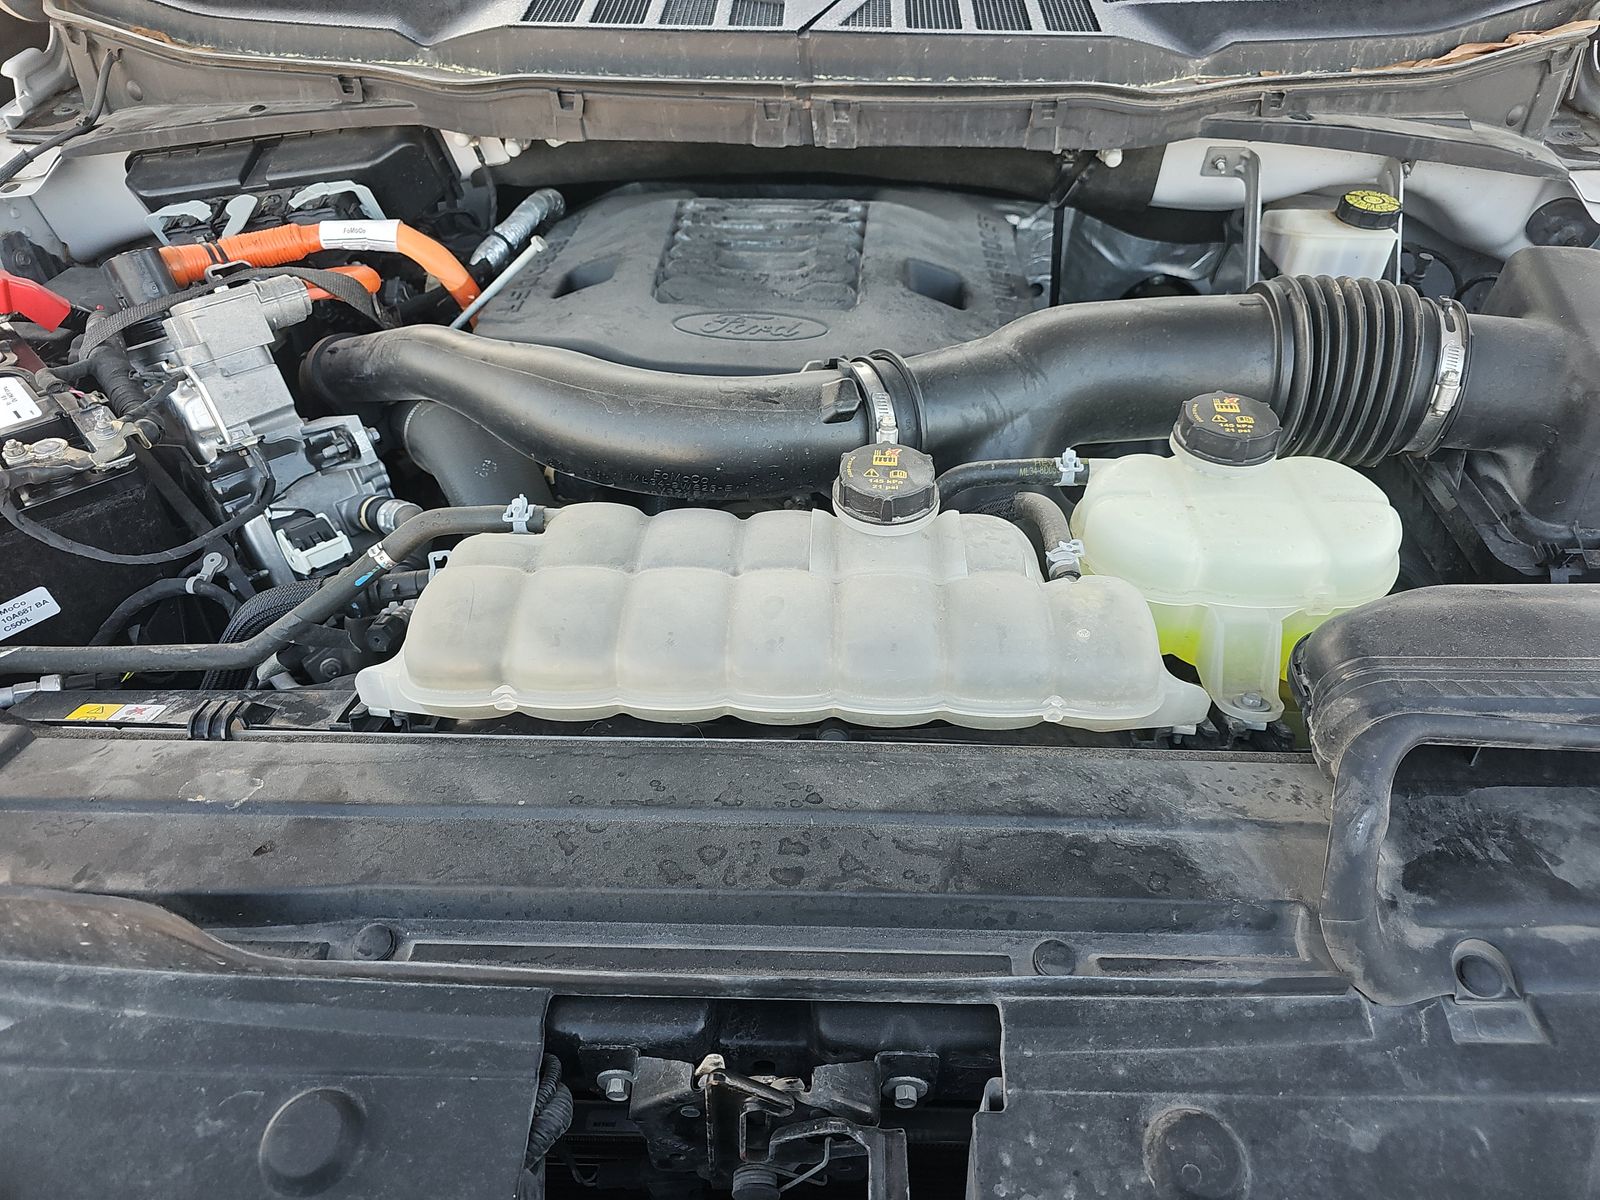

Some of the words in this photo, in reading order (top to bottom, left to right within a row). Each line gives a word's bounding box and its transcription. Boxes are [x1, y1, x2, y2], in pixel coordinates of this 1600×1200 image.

[701, 314, 802, 338] Ford
[34, 600, 50, 609] BA
[4, 617, 33, 632] C500L
